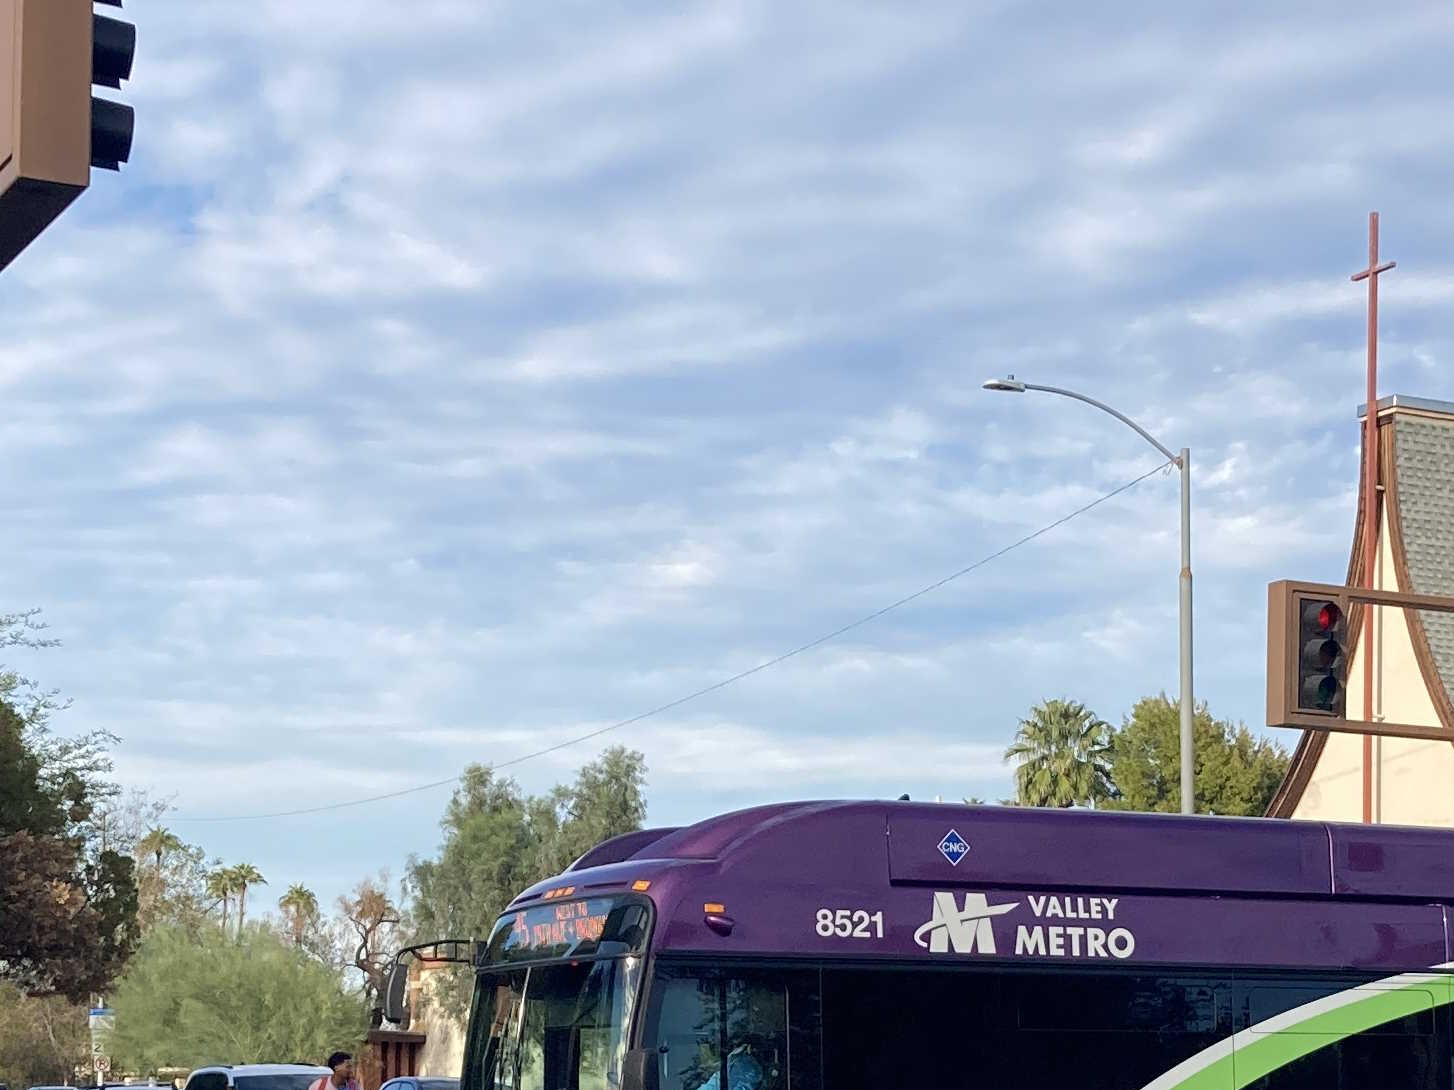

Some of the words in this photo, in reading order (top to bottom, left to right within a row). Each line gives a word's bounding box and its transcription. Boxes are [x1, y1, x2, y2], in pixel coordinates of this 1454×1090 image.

[942, 841, 965, 853] CNG
[1027, 895, 1119, 920] VALLEY
[815, 908, 884, 938] 8521
[1015, 925, 1136, 959] METRO
